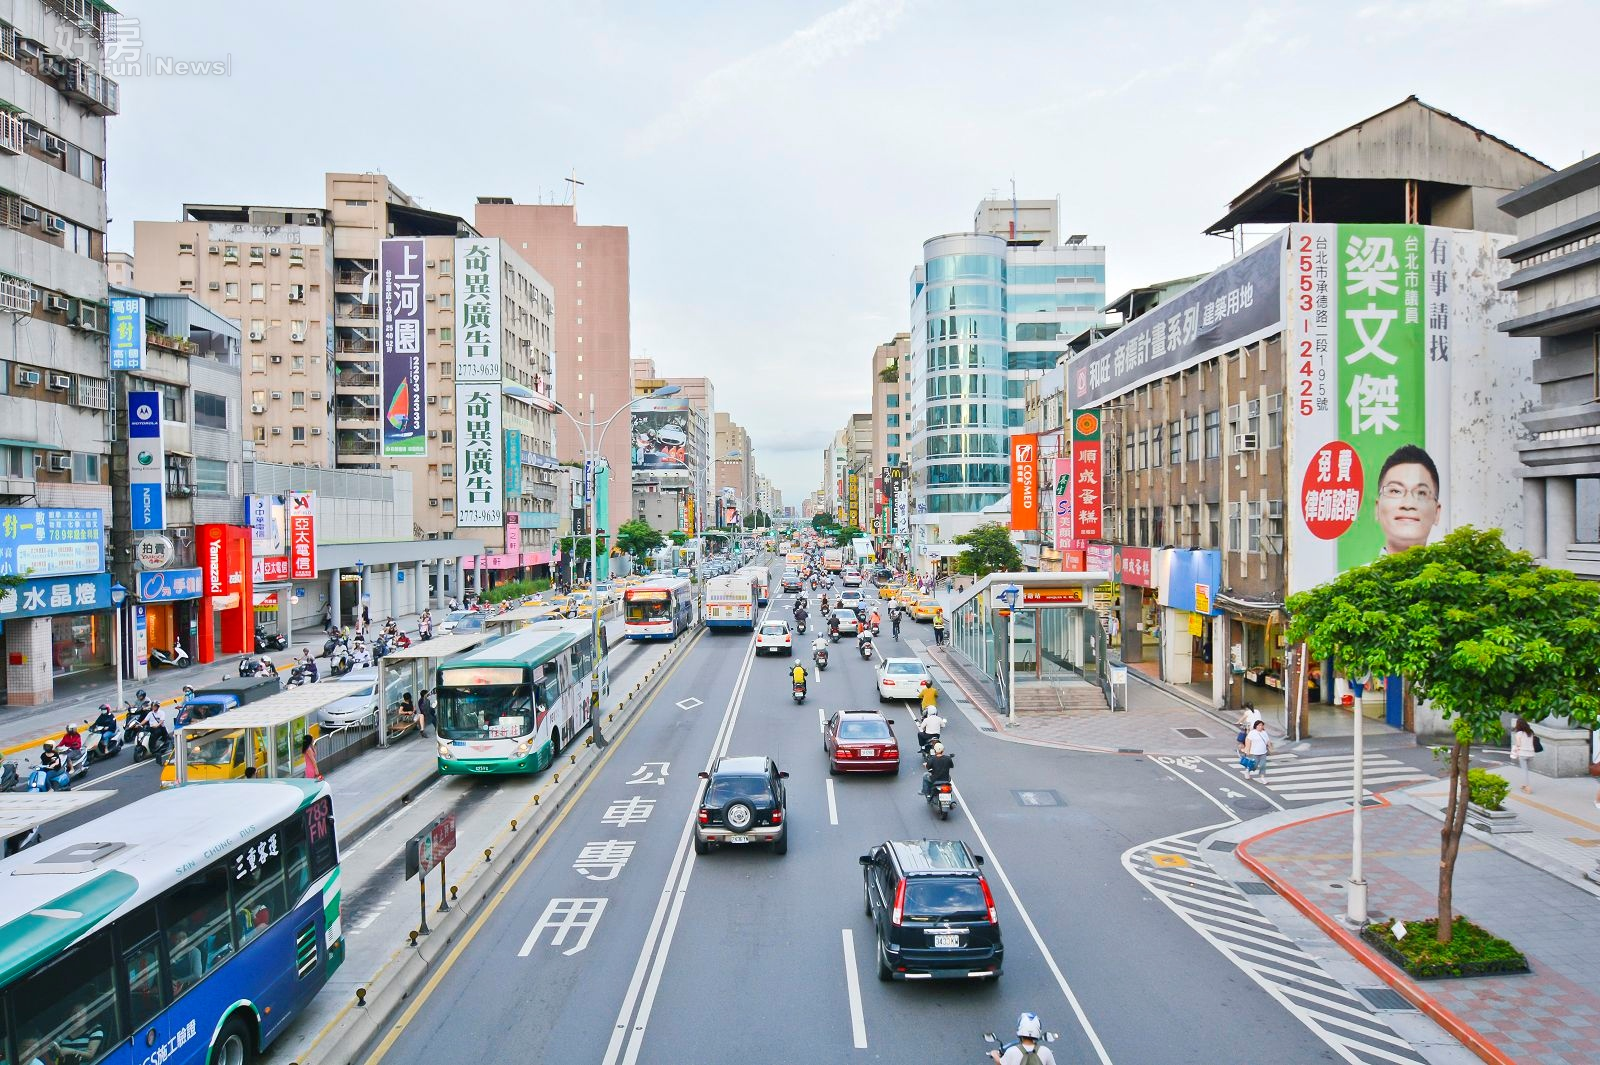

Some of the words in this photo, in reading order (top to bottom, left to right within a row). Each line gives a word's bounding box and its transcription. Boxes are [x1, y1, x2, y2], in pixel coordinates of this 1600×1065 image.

[393, 245, 421, 354] 上河園
[463, 244, 492, 358] 奇異廣告
[1404, 235, 1419, 325] 台北市議員
[1429, 238, 1449, 363] 有事請找
[1089, 352, 1112, 391] 和旺
[1113, 301, 1200, 378] 帝標計畫系列
[1202, 281, 1255, 327] 建築用地
[1299, 235, 1313, 416] 2553-2425
[1344, 234, 1400, 436] 梁文傑
[458, 363, 499, 377] 2773-9639
[464, 391, 494, 504] 奇異廣告
[1317, 449, 1353, 483] 免費
[143, 487, 151, 525] NOKIA
[1023, 464, 1033, 509] COSMED
[460, 510, 501, 523] 2773-9639
[210, 539, 223, 593] Yamazaki
[264, 561, 288, 575] 亞太電信
[294, 517, 311, 571] 亞太電信
[306, 799, 328, 826] 783
[310, 816, 327, 844] FM
[235, 833, 279, 880] 三重客運
[517, 762, 671, 957] 公車專用
